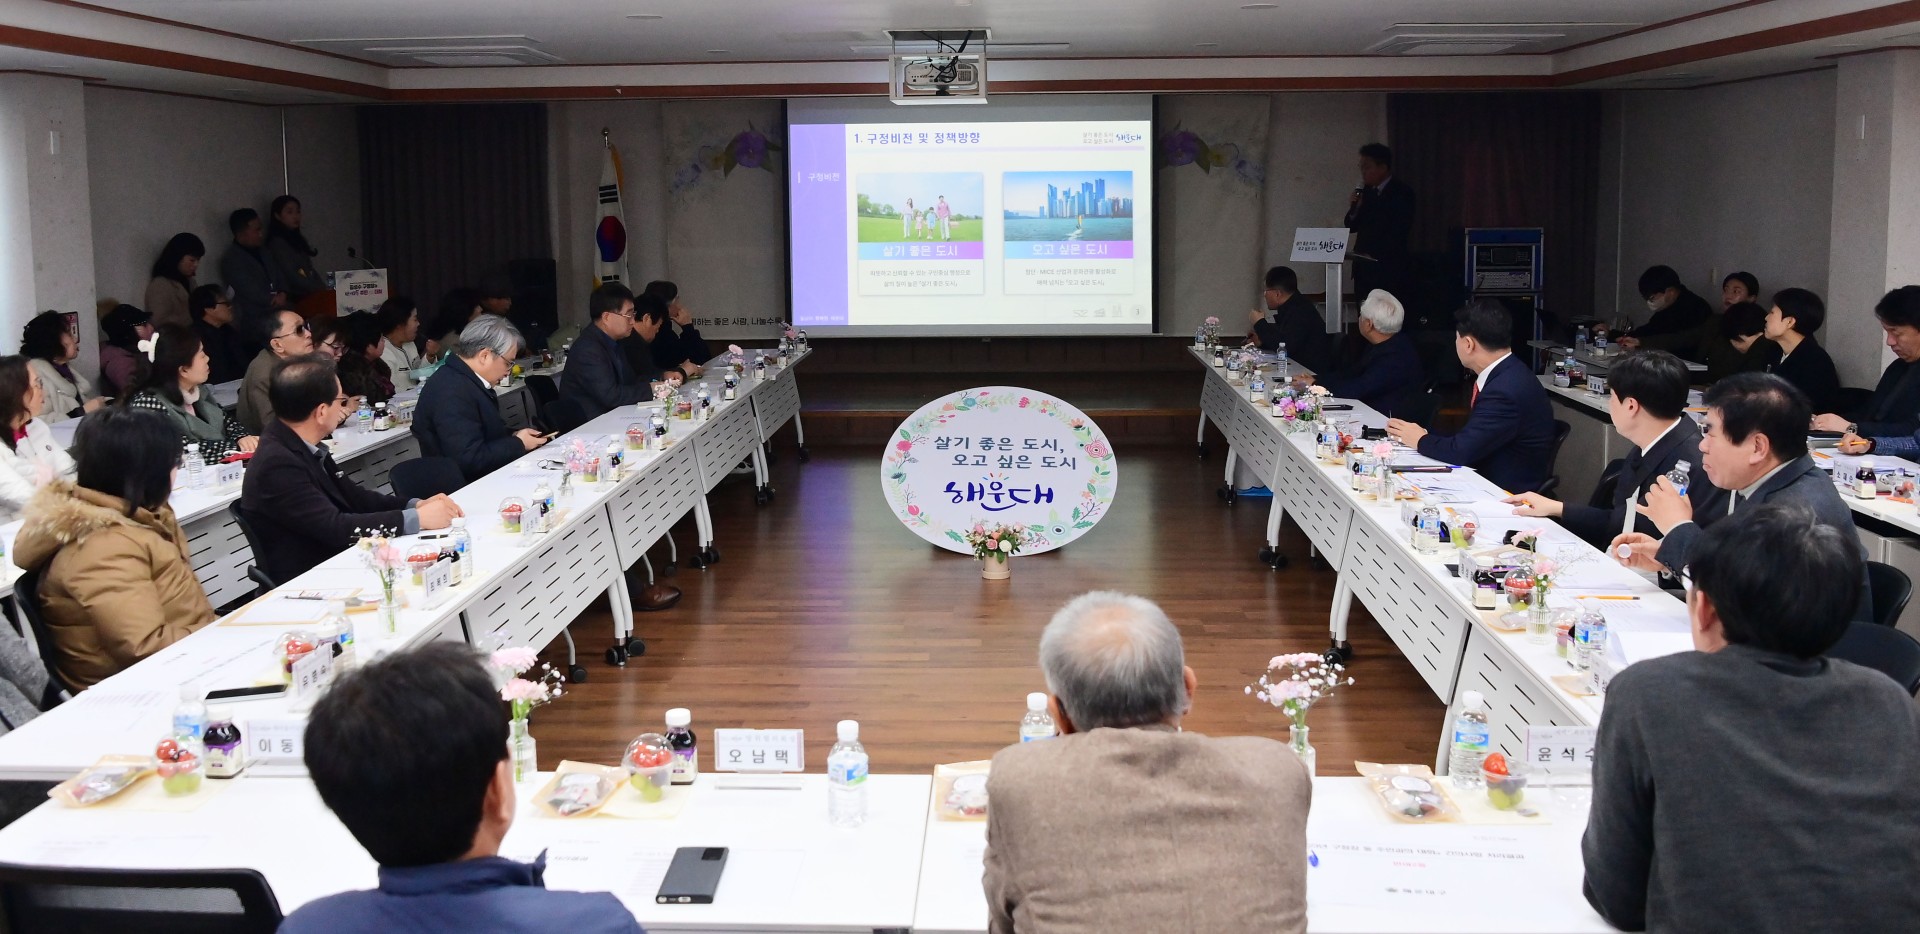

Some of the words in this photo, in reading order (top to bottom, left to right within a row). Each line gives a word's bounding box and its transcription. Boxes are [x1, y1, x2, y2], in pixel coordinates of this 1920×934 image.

[855, 133, 863, 143] 1.
[867, 133, 913, 144] 구정비전
[918, 132, 928, 144] 및
[935, 132, 981, 144] 정책방향
[808, 172, 840, 182] 구정비전
[883, 245, 905, 257] 살기
[910, 245, 931, 257] 좋은
[936, 245, 958, 257] 도시
[1033, 244, 1054, 255] 오고
[1059, 244, 1080, 255] 싶은
[1086, 244, 1108, 255] 도시
[714, 317, 729, 326] 좋은
[732, 317, 750, 326] 사람,
[935, 437, 969, 450] 살기
[978, 437, 1014, 450] 좋은
[1022, 437, 1064, 453] 도시,
[951, 454, 988, 466] 오고
[997, 454, 1032, 469] 싶은
[1040, 455, 1076, 470] 도시
[943, 481, 1054, 511] 해운대
